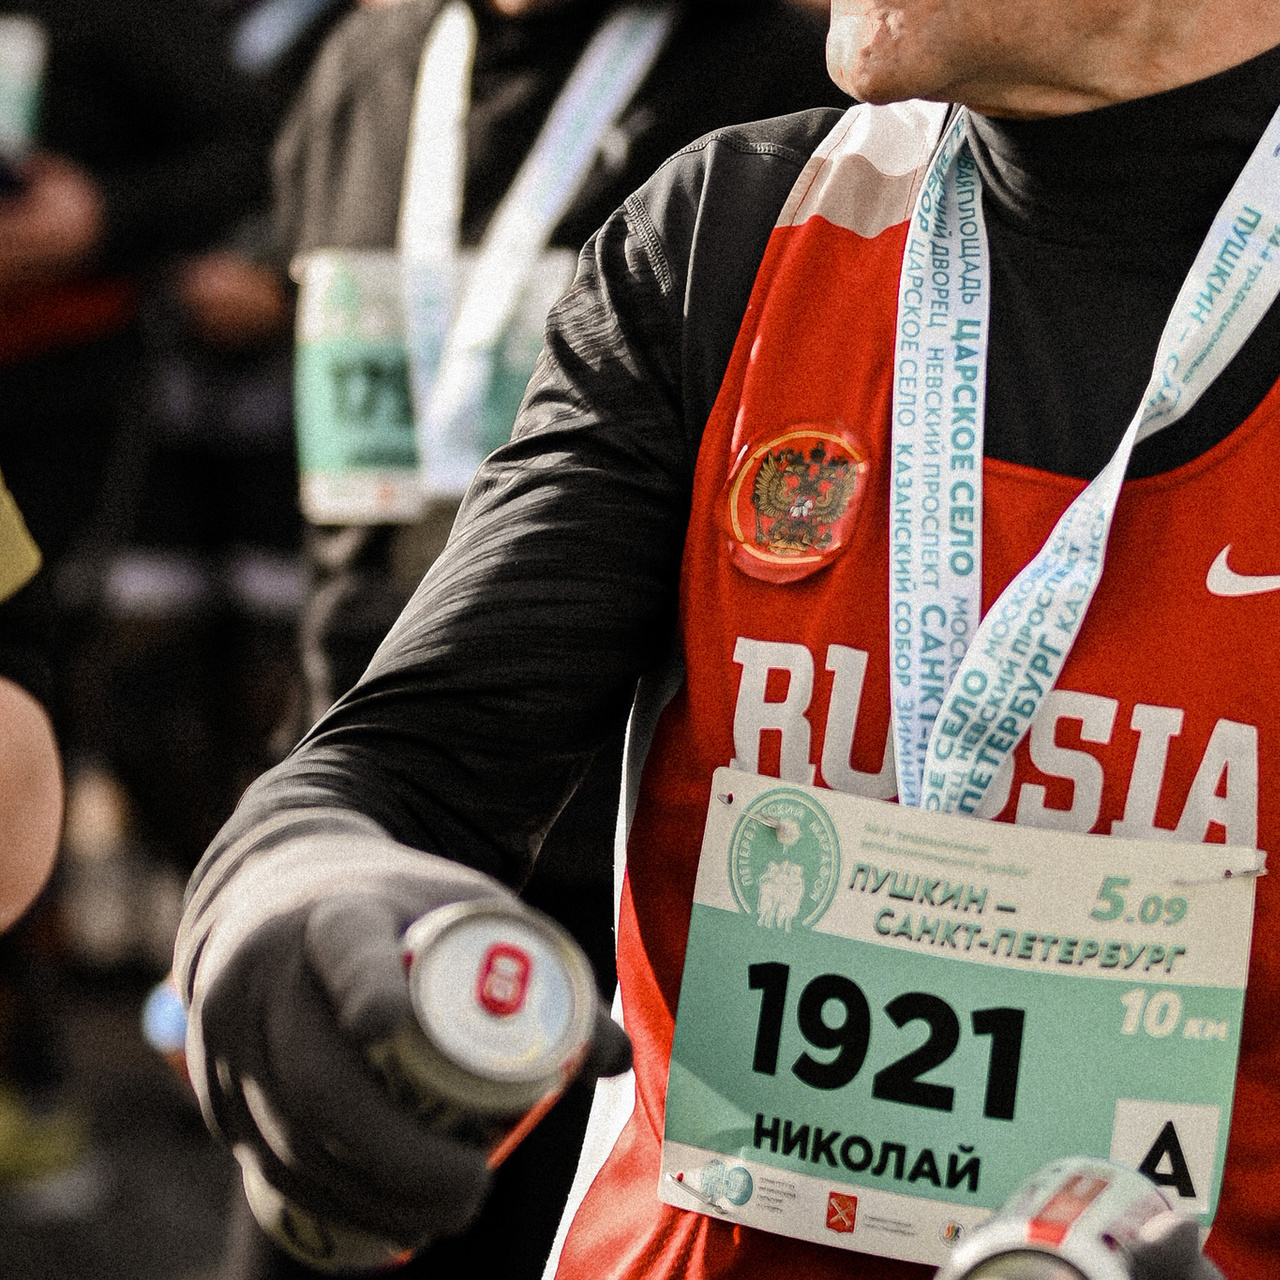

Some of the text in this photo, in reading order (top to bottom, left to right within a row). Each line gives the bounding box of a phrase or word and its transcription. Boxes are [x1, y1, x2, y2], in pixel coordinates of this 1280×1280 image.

[900, 237, 926, 352] ЦАРСКОЕ
[926, 240, 951, 328] ДВОРЕЦ
[956, 189, 982, 306] ПЛОЩАДЬ
[1188, 204, 1263, 325] ПУШКИН
[897, 359, 918, 427] СЕЛО
[923, 347, 946, 456] НЕВСКИЙ
[950, 318, 982, 471] ЦАРСКОЕ
[894, 443, 916, 593] КАЗАНСКИЙ
[921, 463, 940, 589] ПРОСПЕКТ
[948, 480, 975, 576] СЕЛО
[894, 601, 912, 687] СОБОР
[732, 637, 1259, 845] RUSIA
[895, 698, 916, 808] ЗИМНИ
[934, 668, 988, 760] СЕЛО
[958, 633, 1061, 814] ПЕТЕРБУРГ
[849, 861, 989, 915] ПУШКИН
[873, 908, 1187, 976] САНКТ-ПЕТЕРБУРГ
[1090, 874, 1188, 925] 5.09
[747, 959, 1027, 1124] 1921
[1120, 987, 1180, 1040] 10
[751, 1112, 983, 1195] НИКОЛАЙ
